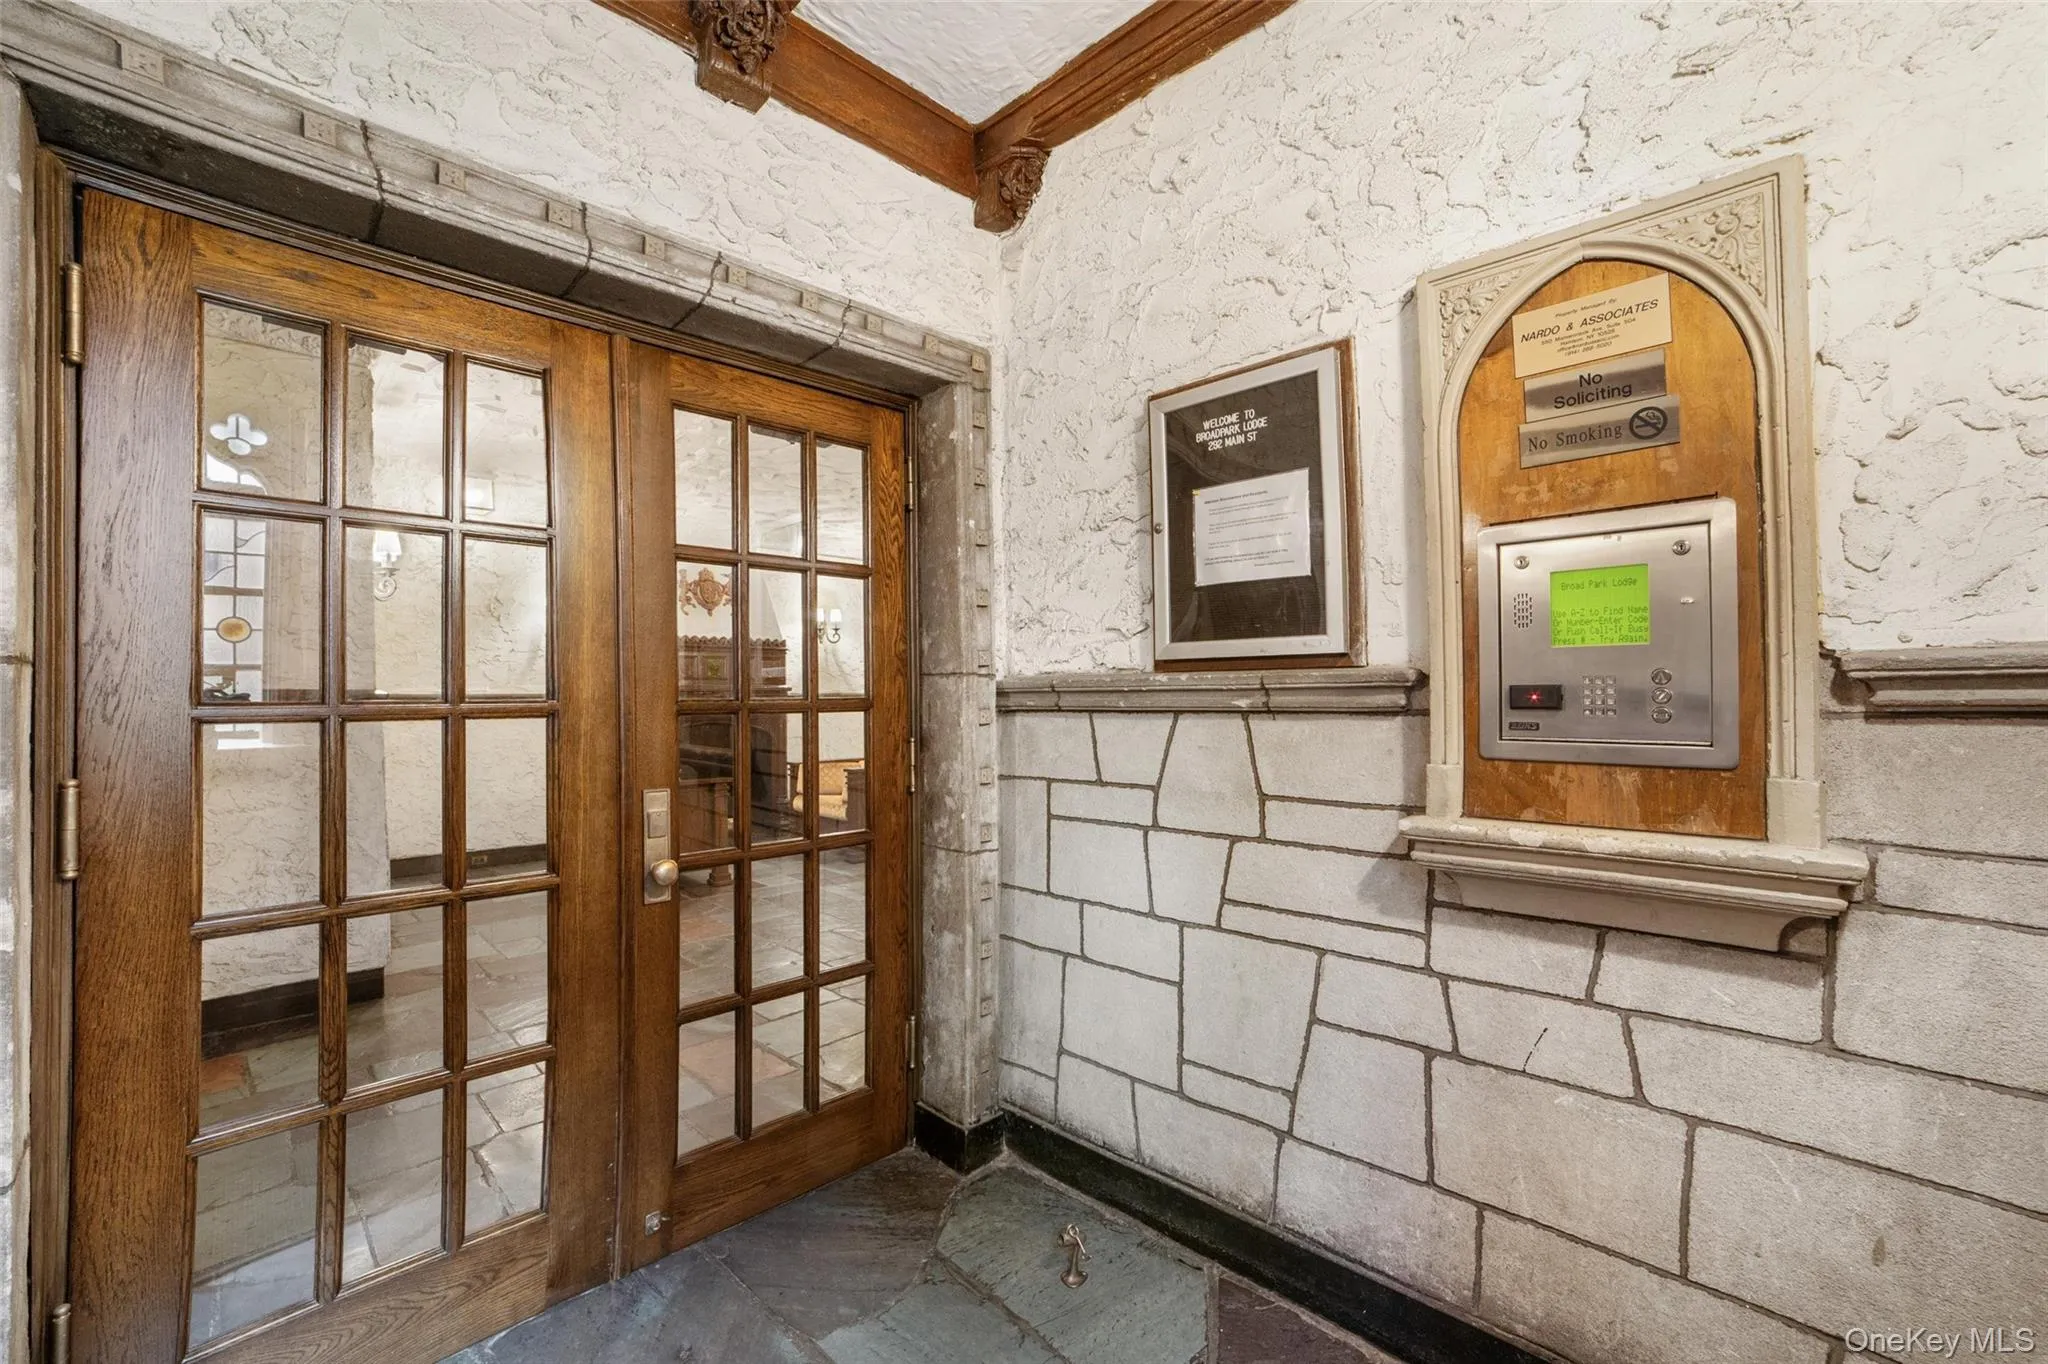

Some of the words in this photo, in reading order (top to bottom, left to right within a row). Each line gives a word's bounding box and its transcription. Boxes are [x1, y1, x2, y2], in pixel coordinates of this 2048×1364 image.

[1520, 325, 1560, 343] NARDO
[1566, 322, 1573, 332] &
[1580, 299, 1659, 328] ASSOCIATES
[1579, 373, 1602, 388] No
[1554, 384, 1632, 409] Soliciting
[1196, 424, 1240, 443] BROADPARK
[1243, 416, 1268, 431] LODGE
[1203, 412, 1240, 430] WELCOME
[1244, 409, 1255, 420] TO
[1208, 440, 1223, 451] 292
[1224, 434, 1245, 447] MAIN
[1247, 431, 1258, 442] ST
[1528, 437, 1548, 452] No
[1556, 424, 1622, 447] Smoking
[1560, 582, 1584, 591] Broad
[1588, 580, 1608, 588] Park
[1612, 578, 1637, 587] Lodge
[1603, 606, 1624, 615] Find
